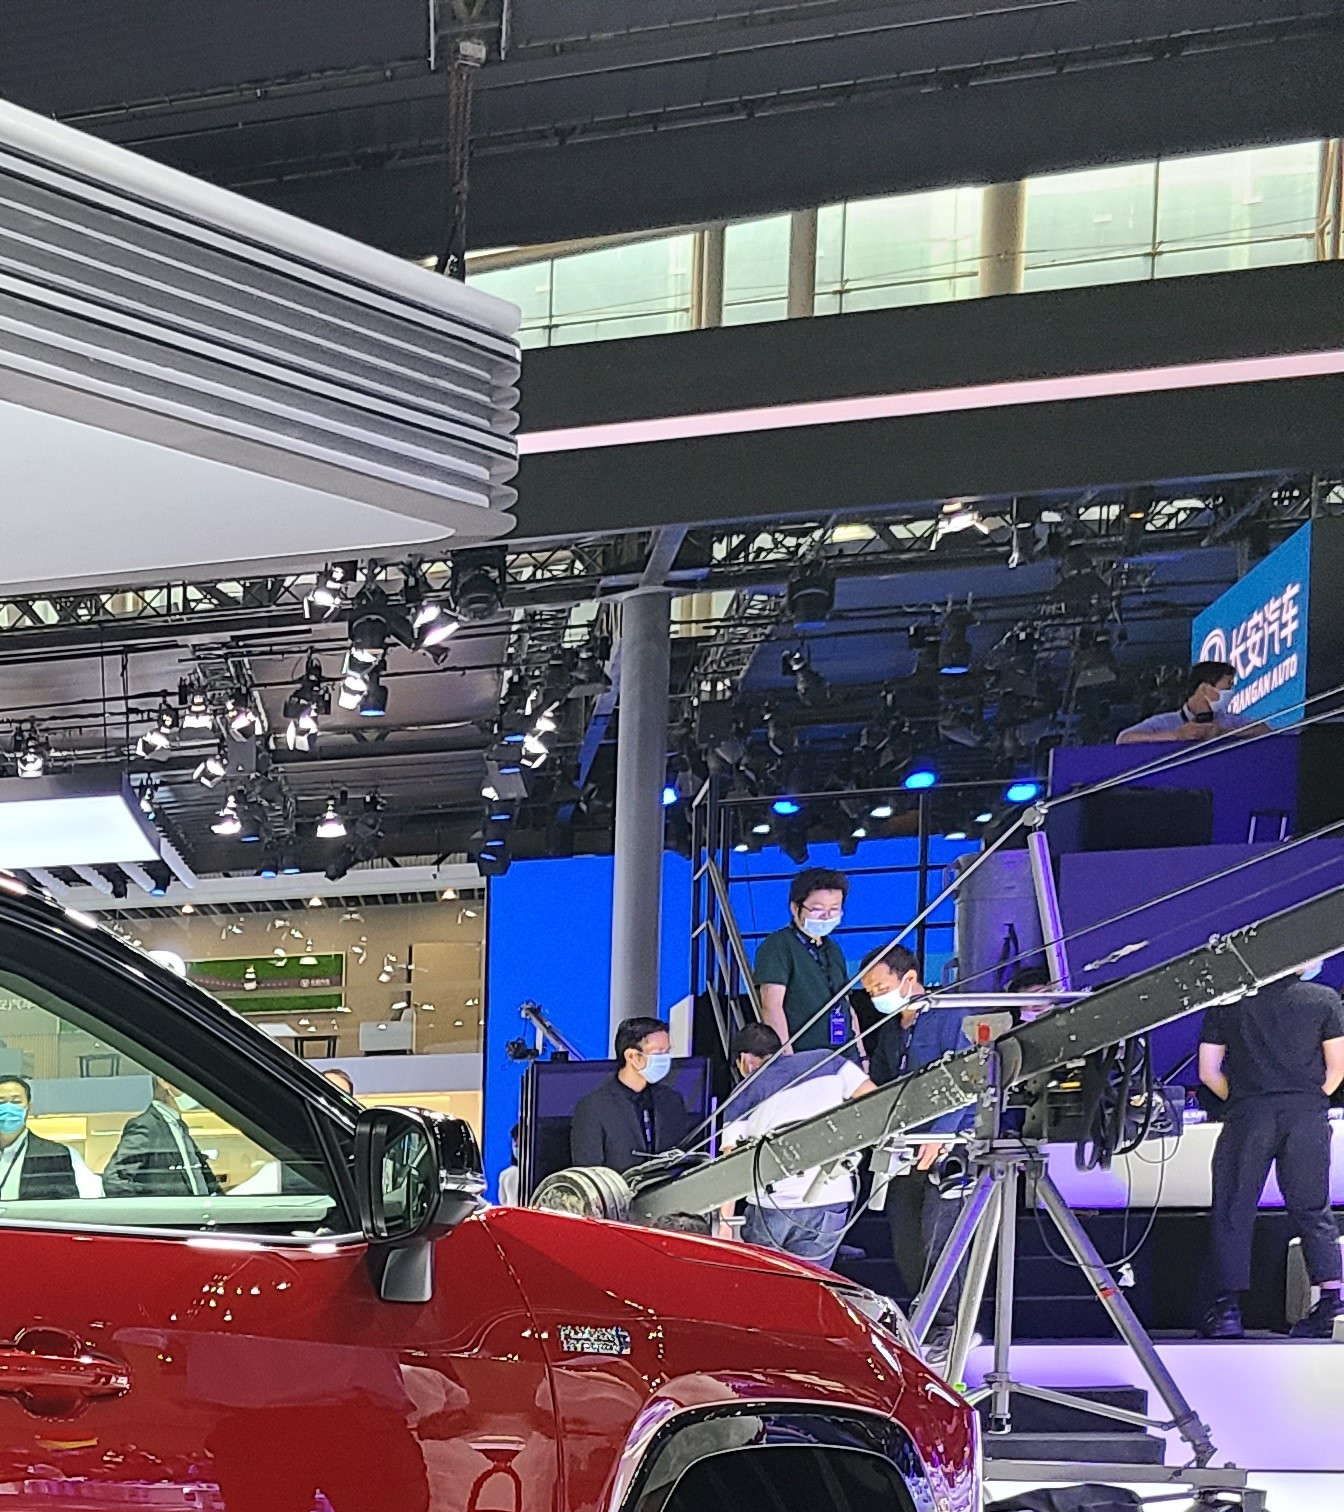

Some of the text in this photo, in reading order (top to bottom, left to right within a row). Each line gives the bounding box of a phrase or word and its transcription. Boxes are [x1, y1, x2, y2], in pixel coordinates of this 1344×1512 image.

[1230, 583, 1300, 686] 长安汽车
[1271, 652, 1298, 691] AUTO
